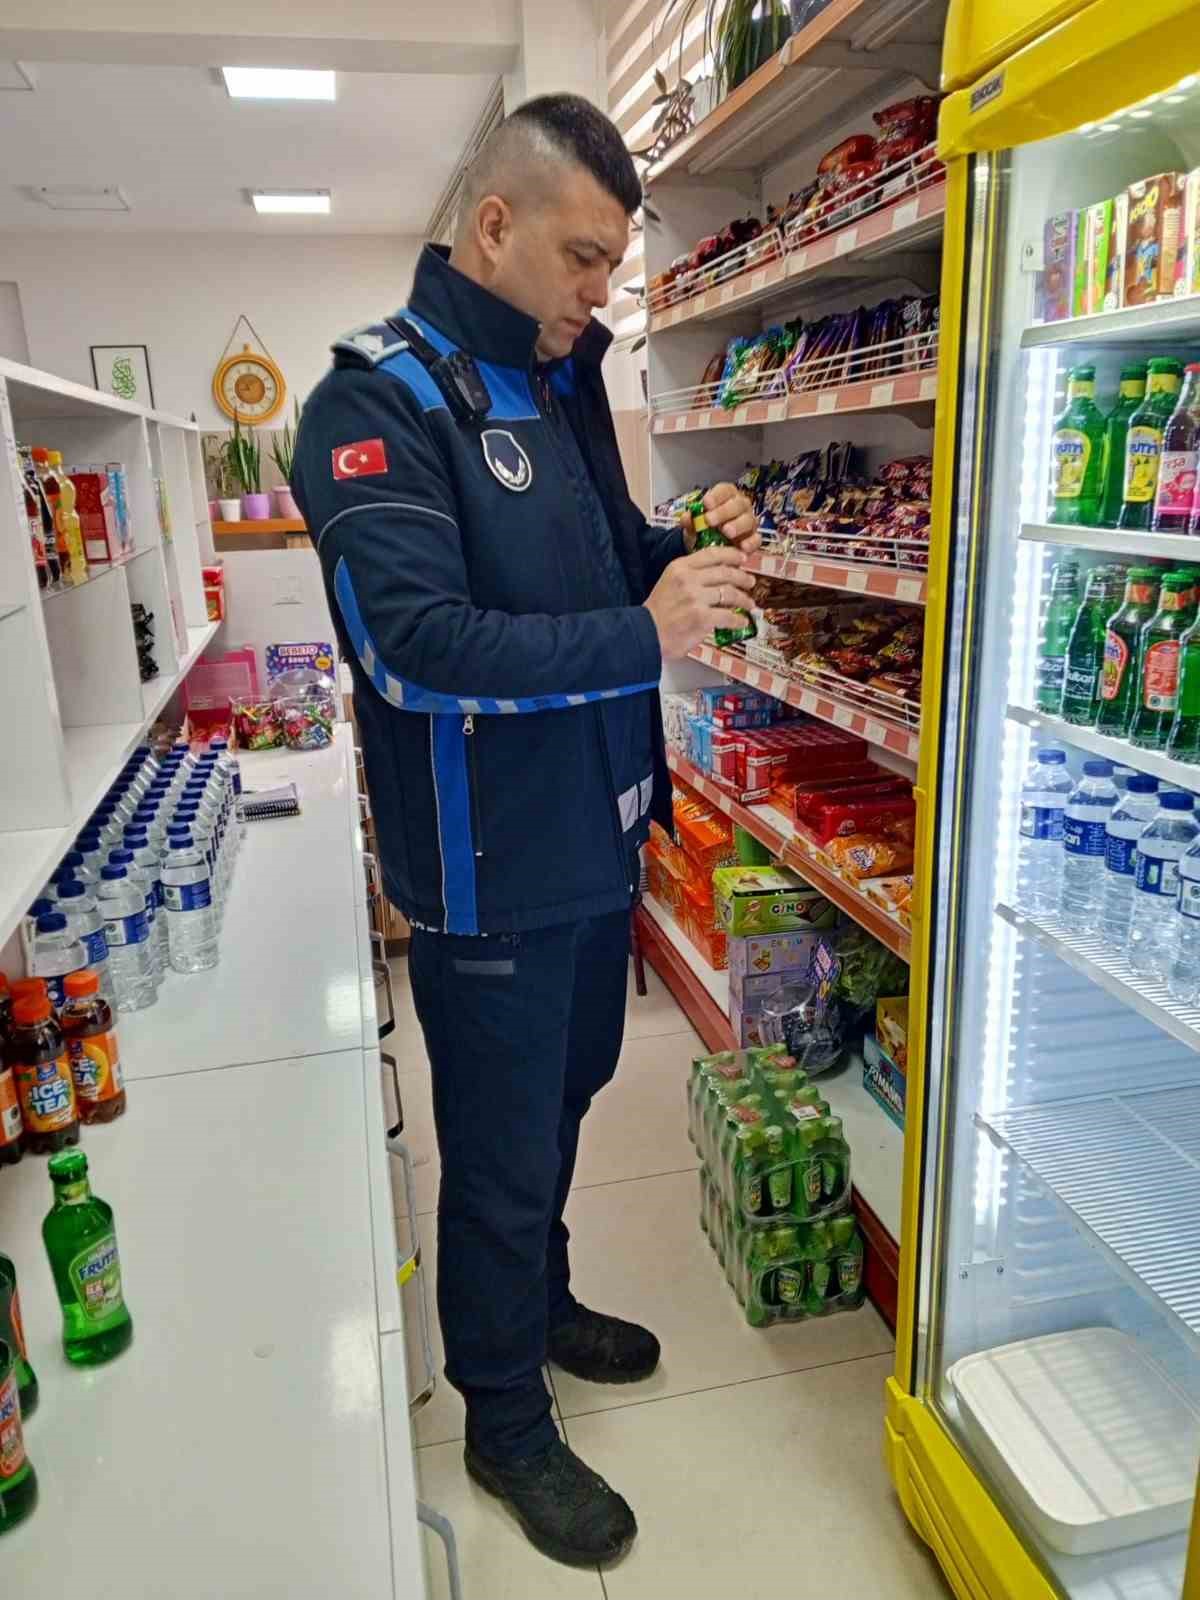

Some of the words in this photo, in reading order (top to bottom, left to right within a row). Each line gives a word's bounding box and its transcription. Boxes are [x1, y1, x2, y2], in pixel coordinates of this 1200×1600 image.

[32, 1080, 65, 1099] ICE
[31, 1093, 69, 1115] TEA
[79, 1248, 118, 1281] FRUT
